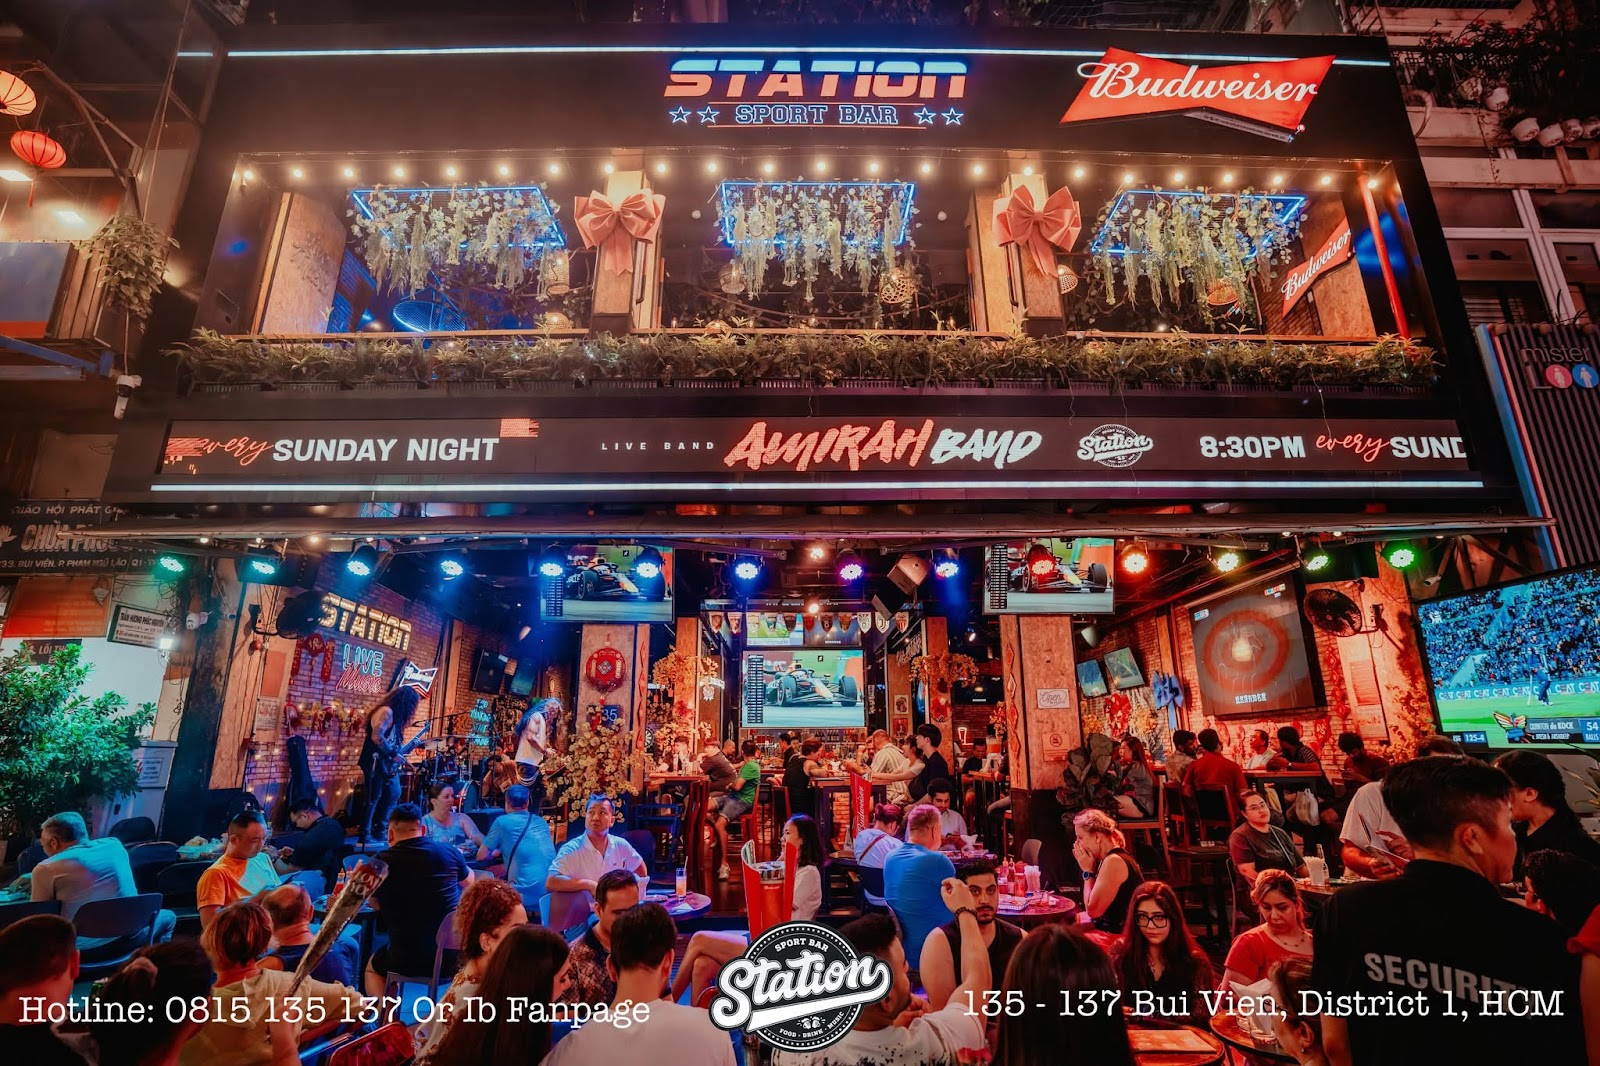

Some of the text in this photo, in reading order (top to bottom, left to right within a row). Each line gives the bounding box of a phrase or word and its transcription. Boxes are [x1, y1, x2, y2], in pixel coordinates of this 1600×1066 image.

[663, 59, 967, 98] STATION
[1076, 61, 1318, 102] Budweiser
[735, 104, 898, 125] SPORT BAR
[1281, 229, 1351, 300] Budweiser
[1520, 345, 1590, 362] mister
[273, 438, 398, 462] SUNDAY
[405, 437, 499, 461] NIGHT
[601, 442, 647, 450] LIVE
[664, 442, 714, 450] BAND
[1077, 431, 1154, 462] Station
[1199, 435, 1306, 459] 8:30PM
[1315, 433, 1390, 462] every
[317, 592, 412, 651] STATION
[342, 643, 384, 678] LIVE
[1586, 721, 1599, 731] 54
[1363, 951, 1534, 1020] SECURIT
